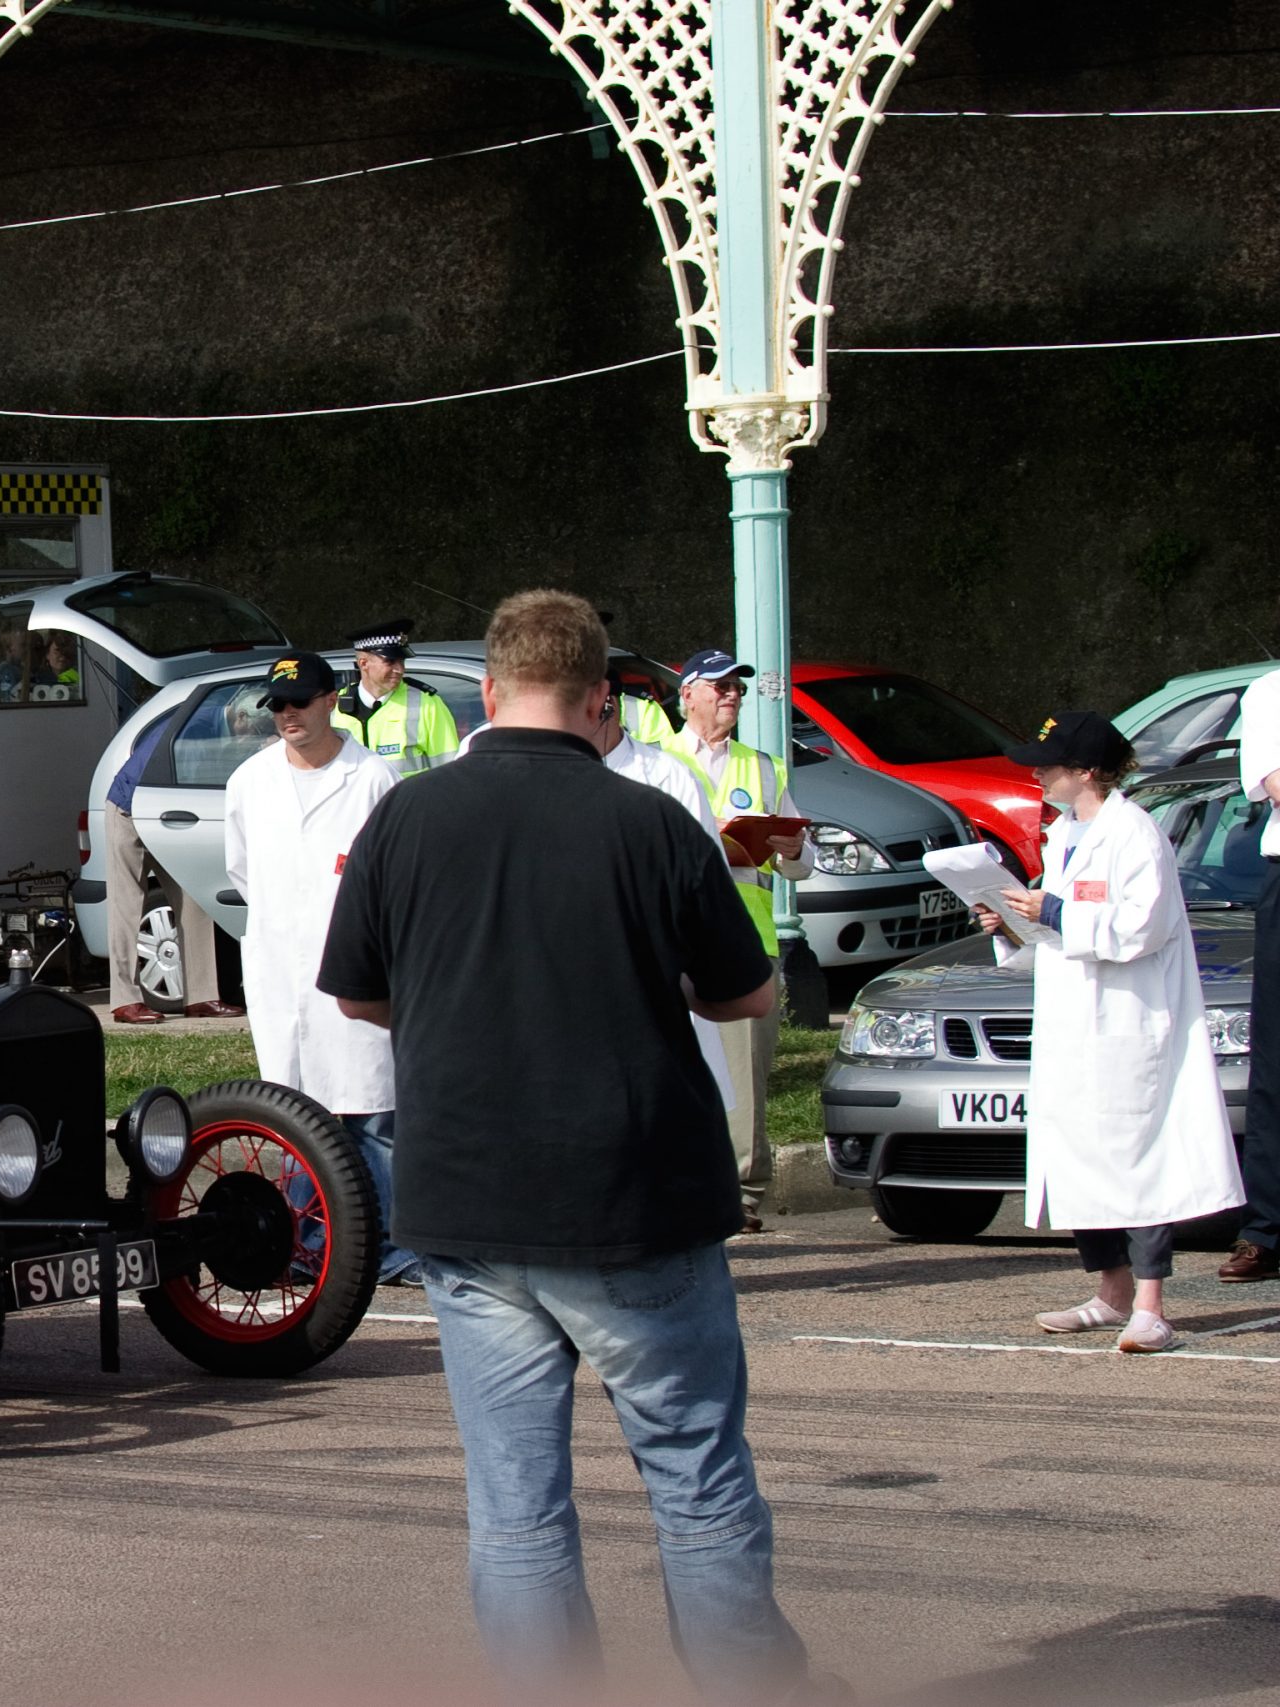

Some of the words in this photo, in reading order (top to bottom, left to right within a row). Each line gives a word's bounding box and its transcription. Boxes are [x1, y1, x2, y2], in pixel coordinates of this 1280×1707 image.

[922, 890, 957, 915] Y758
[951, 1093, 1028, 1123] VK04
[27, 1259, 65, 1302] SV
